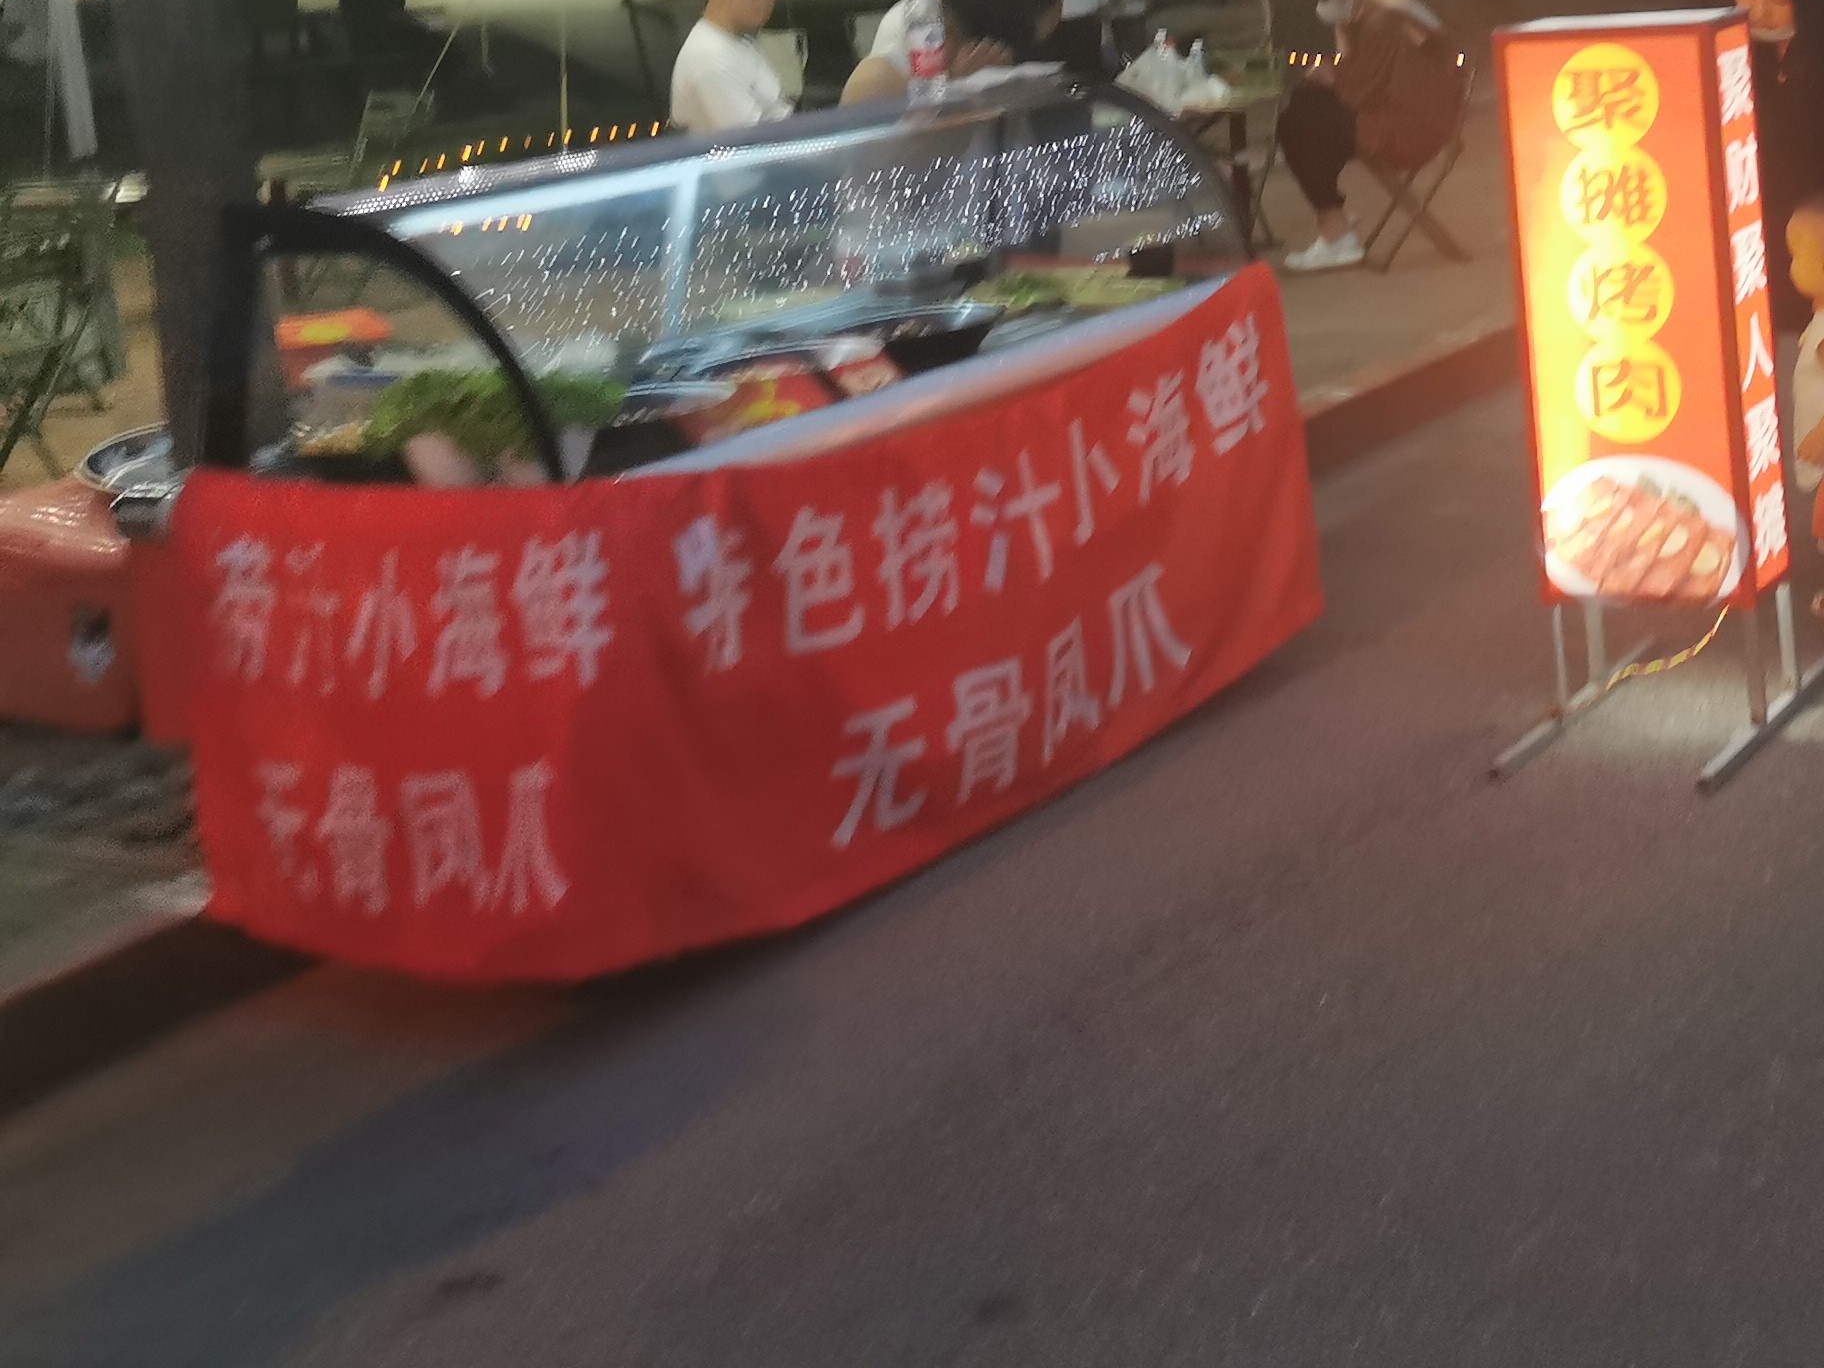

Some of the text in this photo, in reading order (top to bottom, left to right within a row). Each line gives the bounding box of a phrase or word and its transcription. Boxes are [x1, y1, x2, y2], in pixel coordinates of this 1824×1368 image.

[672, 313, 1270, 673] 特色捞汁小海鲜
[829, 561, 1193, 850] 无骨凤爪
